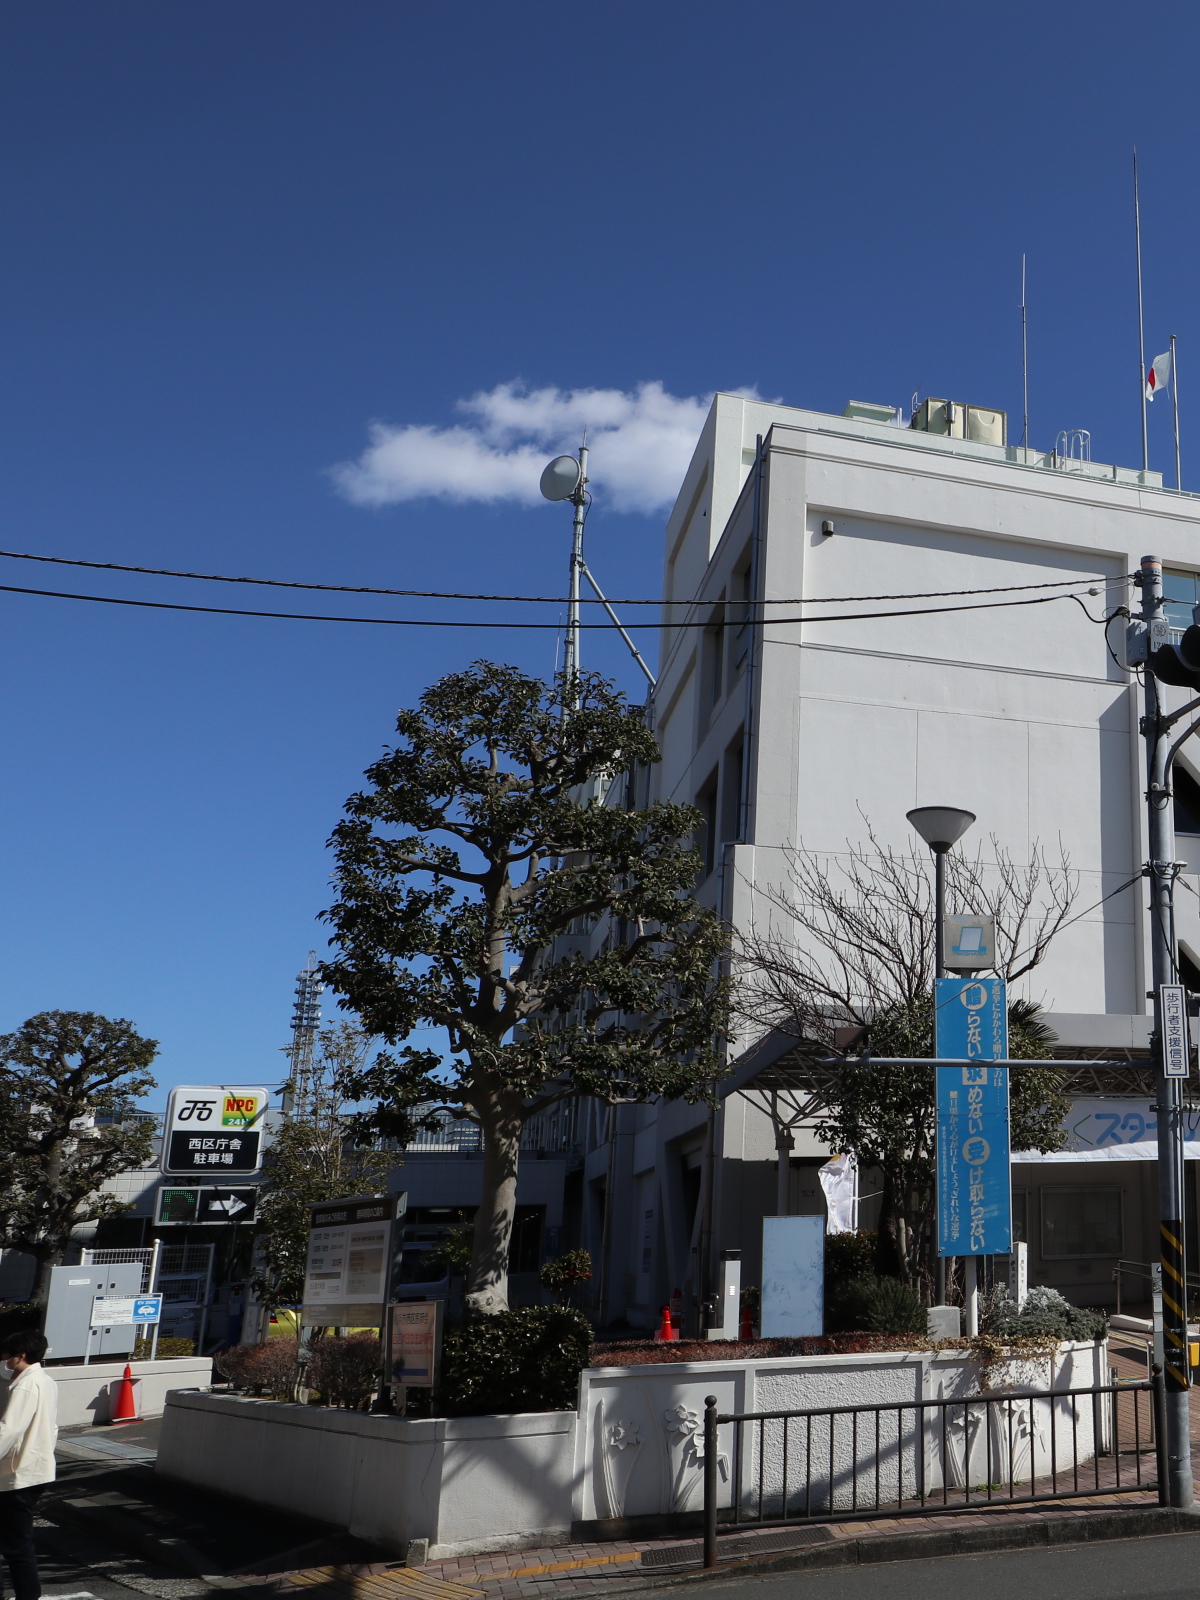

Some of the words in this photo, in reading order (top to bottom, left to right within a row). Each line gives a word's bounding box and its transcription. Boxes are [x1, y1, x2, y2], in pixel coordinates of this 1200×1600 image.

[1166, 992, 1183, 1070] 歩行者支援信号
[226, 1099, 254, 1112] NPC
[188, 1138, 243, 1150] 西区庁舎
[193, 1153, 234, 1165] 駐車場
